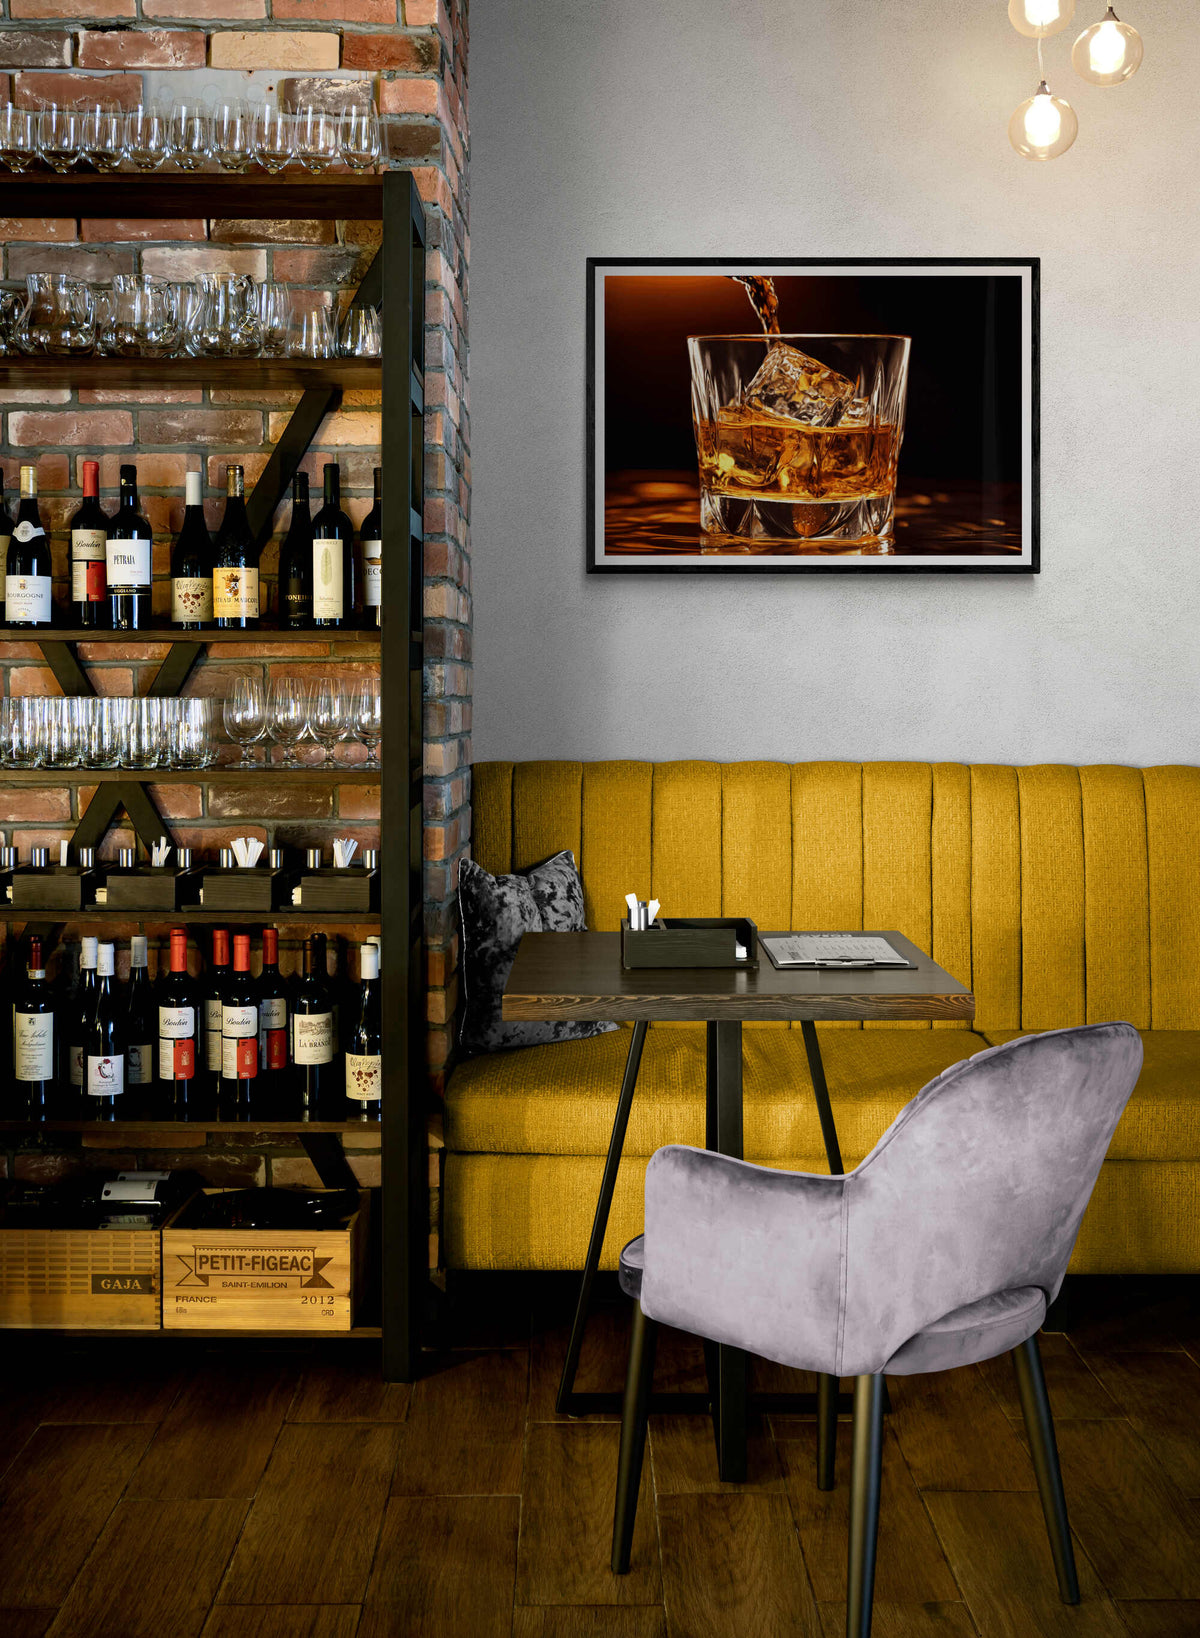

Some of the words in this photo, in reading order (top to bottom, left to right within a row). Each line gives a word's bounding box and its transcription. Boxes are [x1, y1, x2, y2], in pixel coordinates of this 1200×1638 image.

[113, 554, 136, 565] PETRAIA
[7, 591, 44, 599] BOURGOGNE
[199, 1254, 312, 1272] PETIT-FIGEAC
[100, 1278, 143, 1290] GAJA
[221, 1280, 288, 1290] SAINT-EMILION
[175, 1295, 218, 1304] FRANCE
[300, 1295, 335, 1306] 2012
